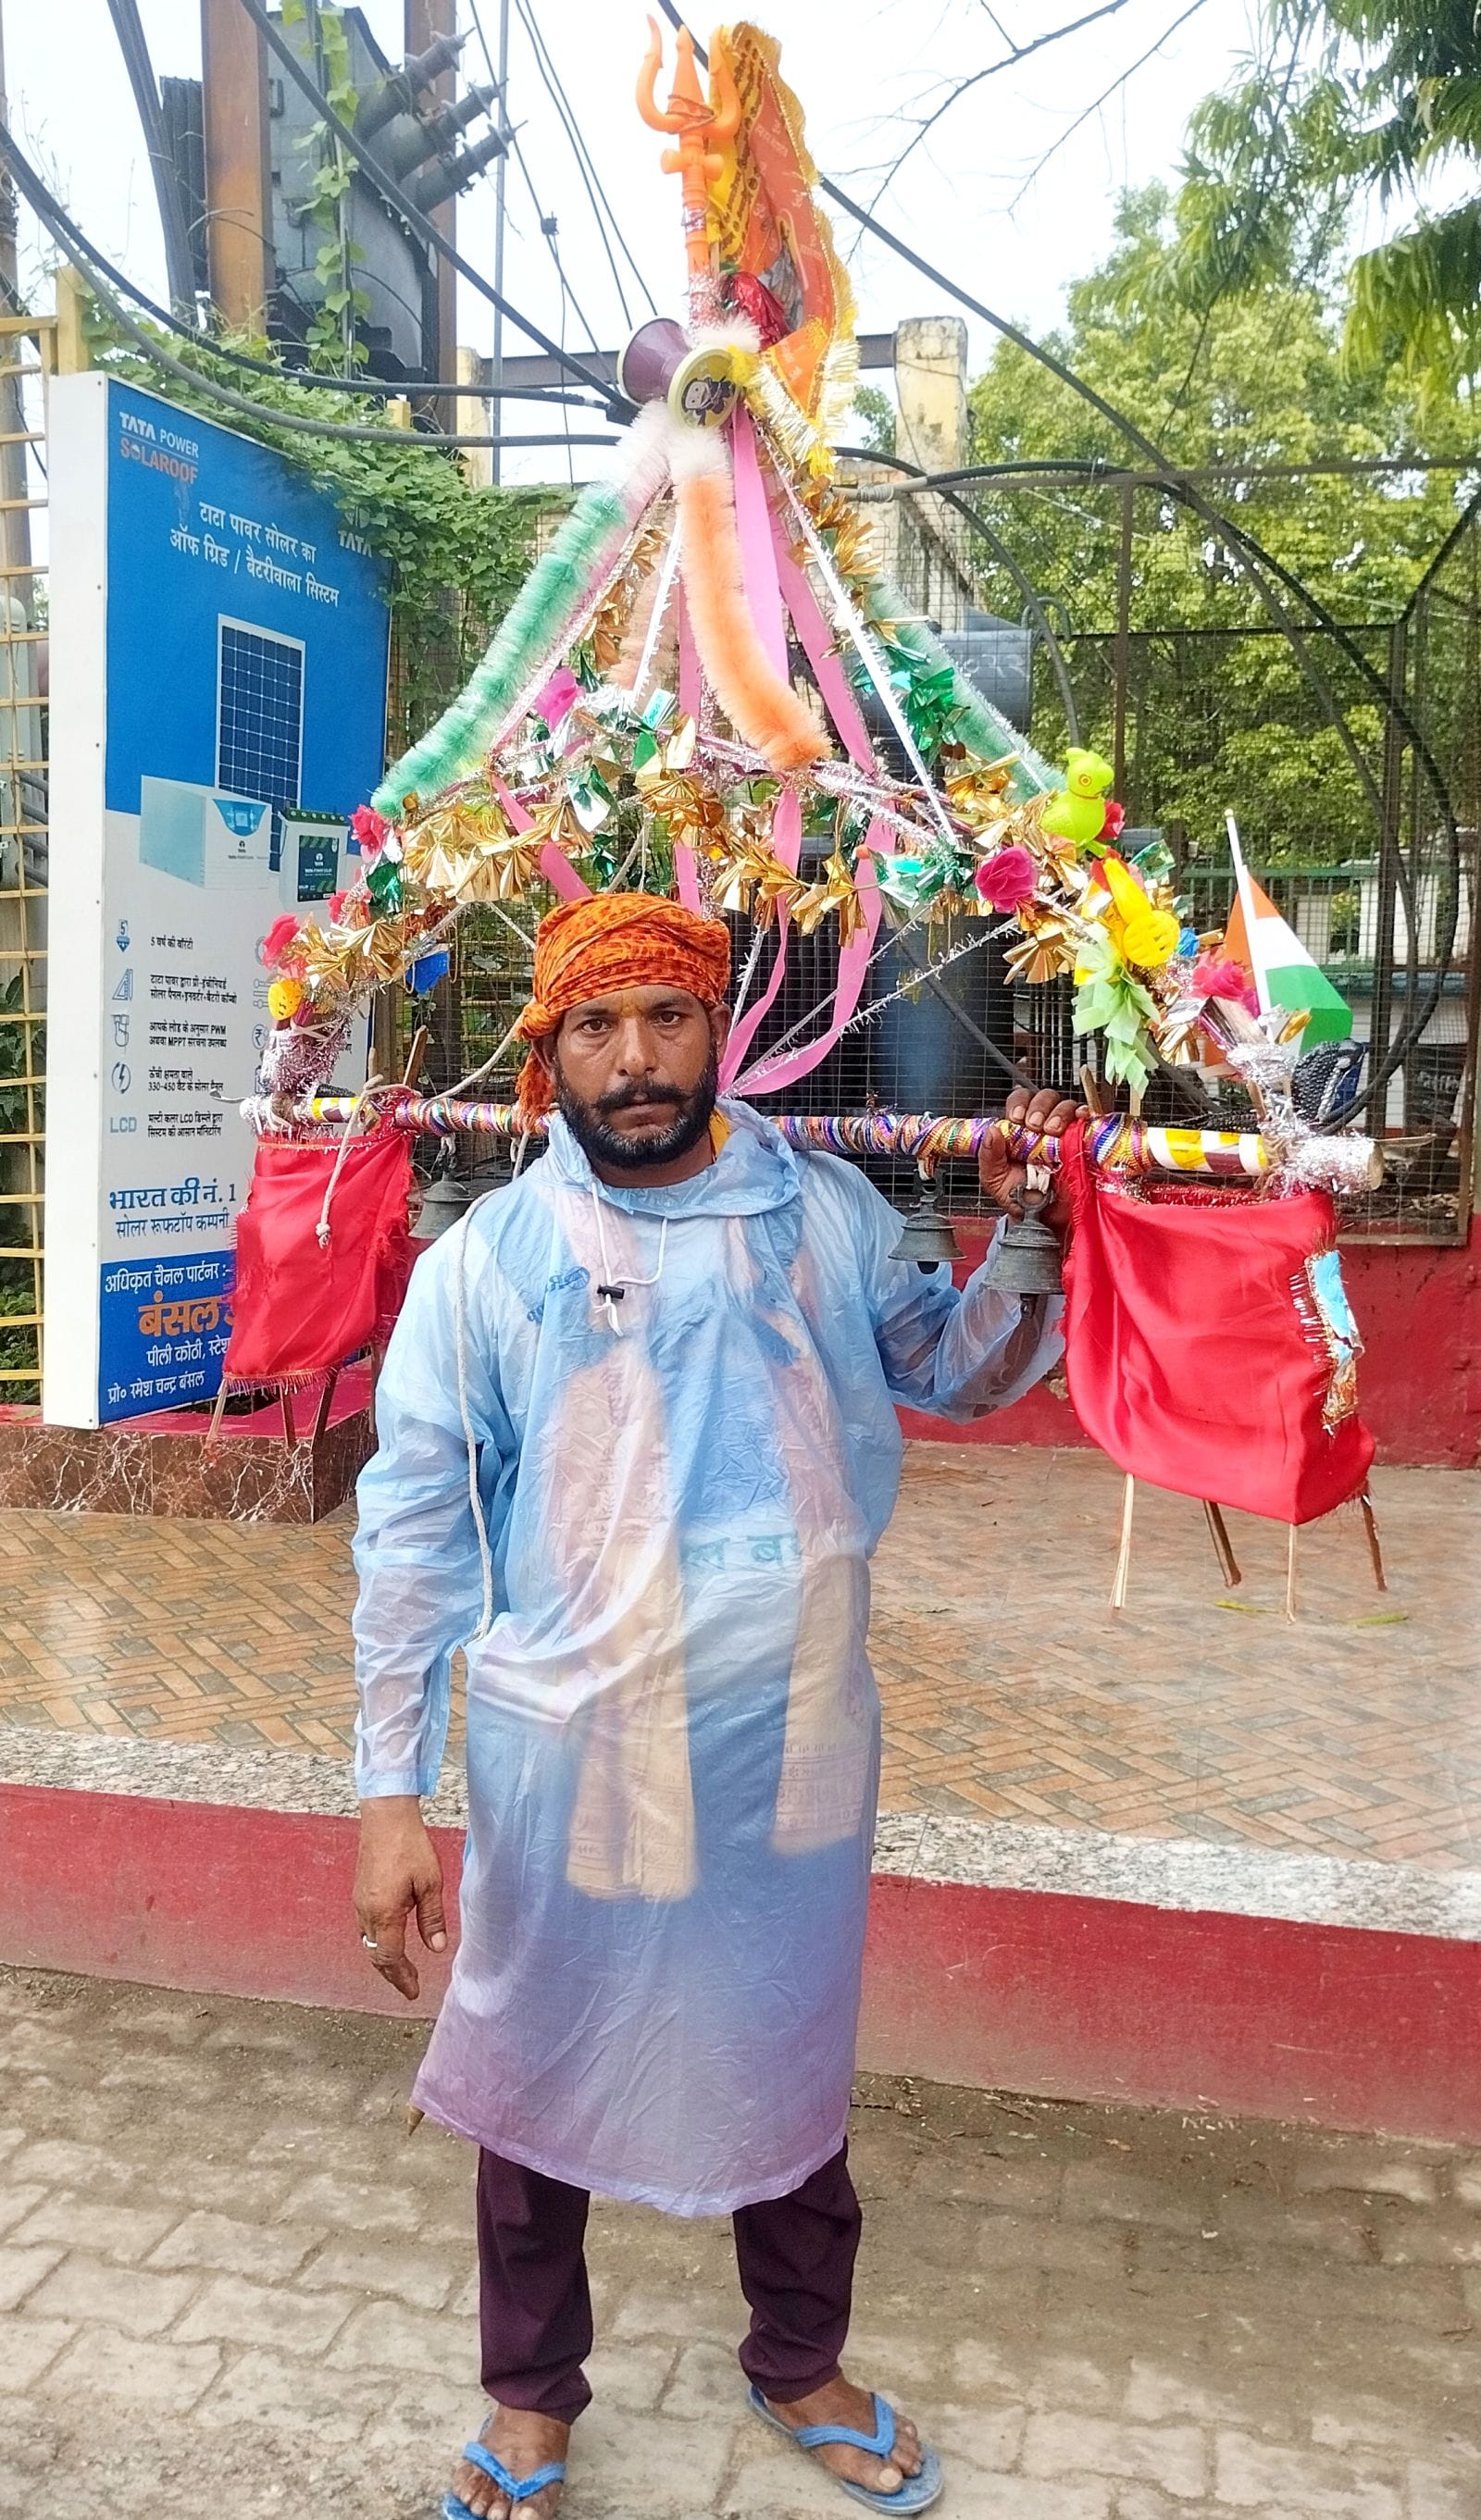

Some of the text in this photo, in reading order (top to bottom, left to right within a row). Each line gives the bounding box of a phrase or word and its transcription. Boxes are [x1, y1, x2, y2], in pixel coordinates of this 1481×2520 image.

[119, 411, 199, 459] TATA POWER
[120, 437, 199, 485] SOLAROOF
[199, 502, 317, 565] टाटा पावर सोलर का
[338, 530, 372, 558] TATA
[169, 523, 340, 608] ऑफ ग्रिड / बैटरीवाला सिस्टम
[150, 937, 156, 946] 5
[156, 935, 166, 948] वर्ष
[168, 936, 176, 949] की
[150, 974, 164, 984] टाटा
[165, 975, 179, 987] पावर
[150, 986, 167, 999] सोलर
[149, 1019, 168, 1032] आपके
[182, 1020, 189, 1033] के
[210, 1024, 226, 1035] PWM
[168, 1037, 186, 1047] MPPT
[148, 1081, 176, 1092] 330-450
[187, 1080, 193, 1091] के
[180, 1067, 193, 1080] वाले
[110, 1116, 137, 1134] LCD
[180, 1113, 193, 1123] LCD
[109, 1188, 167, 1210] भारत
[170, 1177, 200, 1205] की
[229, 1184, 236, 1202] 1
[116, 1207, 230, 1239] सोलर रूफटॉप कम्पनी
[105, 1268, 153, 1294] अधिकृत
[154, 1264, 184, 1286] चैनल
[186, 1260, 219, 1283] पार्टनर
[138, 1290, 221, 1337] बंसल
[146, 1343, 172, 1366] पीली
[130, 1377, 154, 1398] रमेश
[156, 1375, 177, 1394] चन्द्र
[179, 1370, 205, 1390] बंसल
